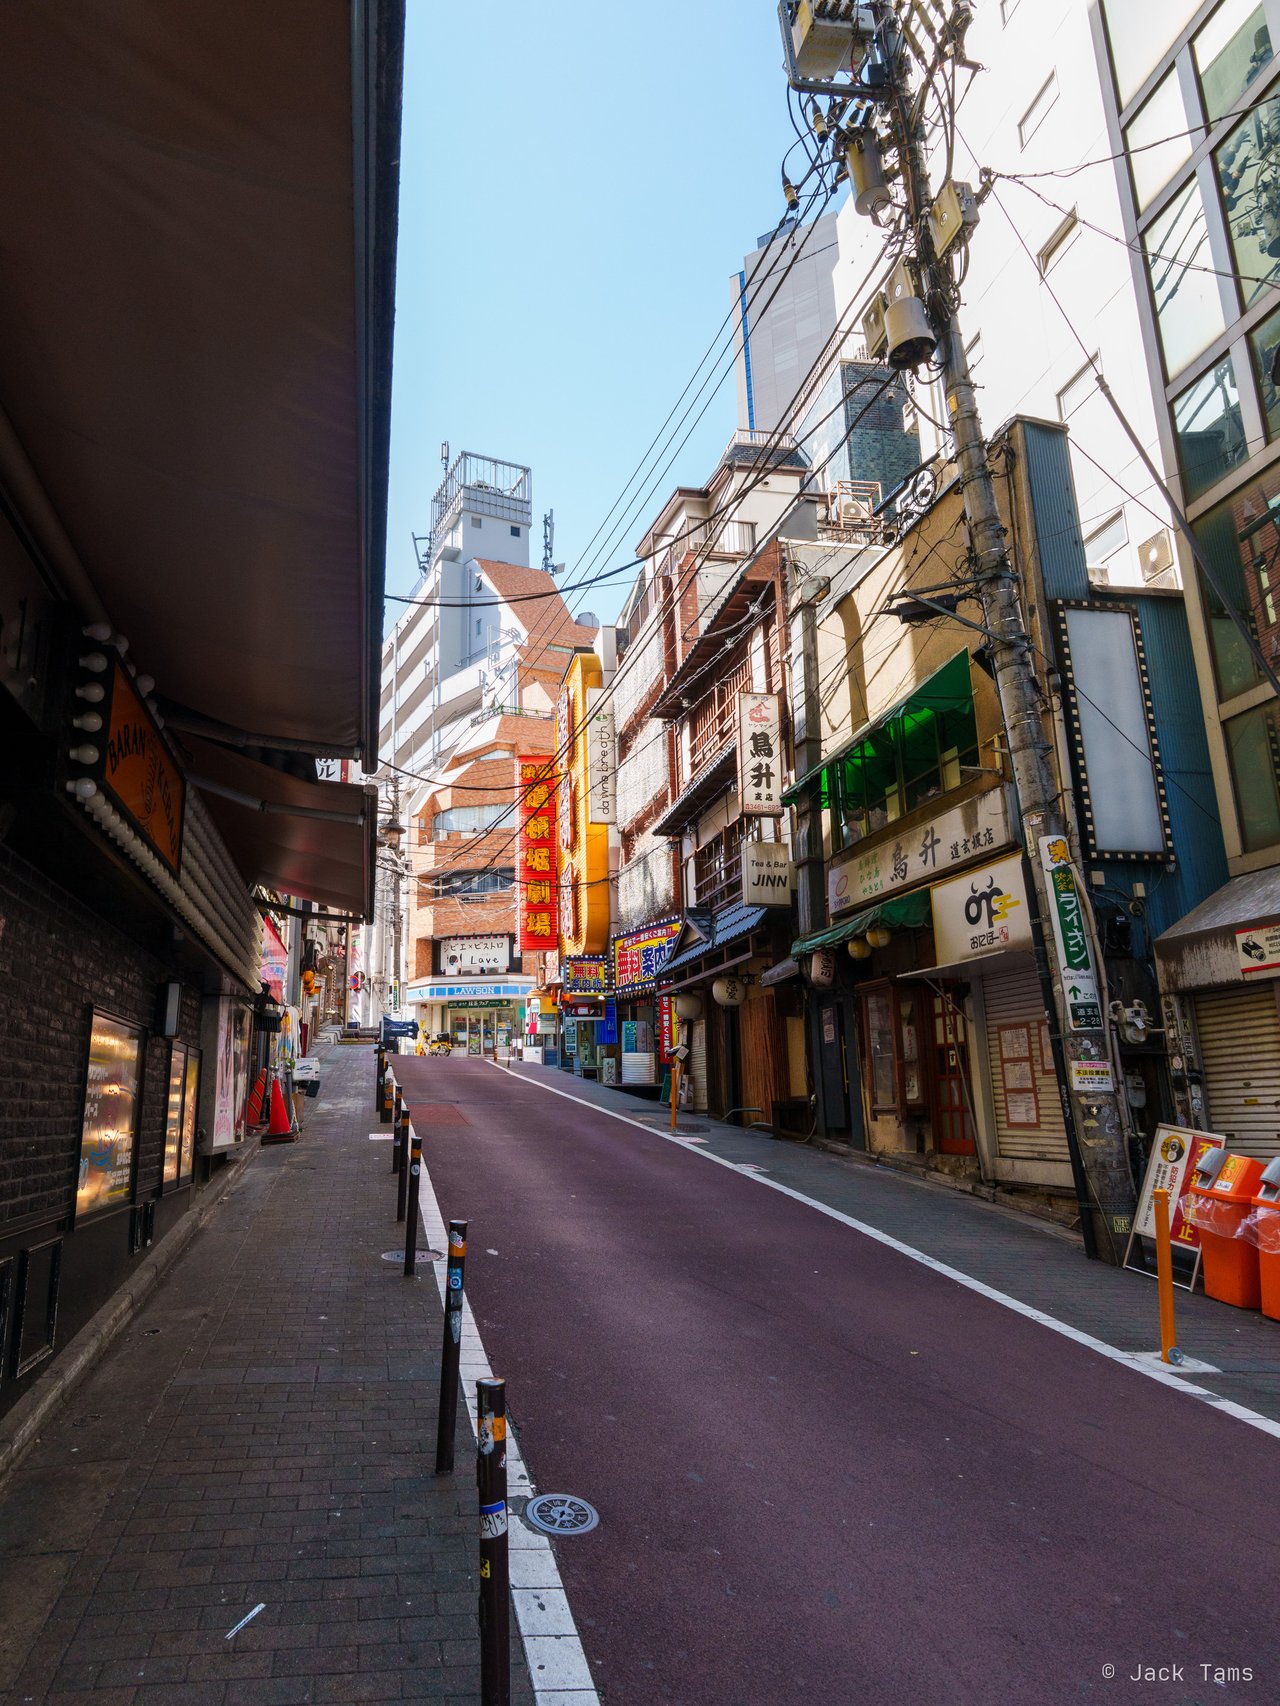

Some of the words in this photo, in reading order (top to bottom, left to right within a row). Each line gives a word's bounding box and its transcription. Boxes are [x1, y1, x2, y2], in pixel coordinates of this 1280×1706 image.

[108, 723, 146, 775] BARAN
[525, 784, 551, 937] 道頓堀劇場
[751, 859, 765, 868] Tea
[752, 874, 788, 888] JINN
[1058, 893, 1087, 964] ライオン
[573, 965, 599, 979] 無料
[454, 986, 495, 995] LAWSON
[1167, 1165, 1179, 1205] 防犯カメ
